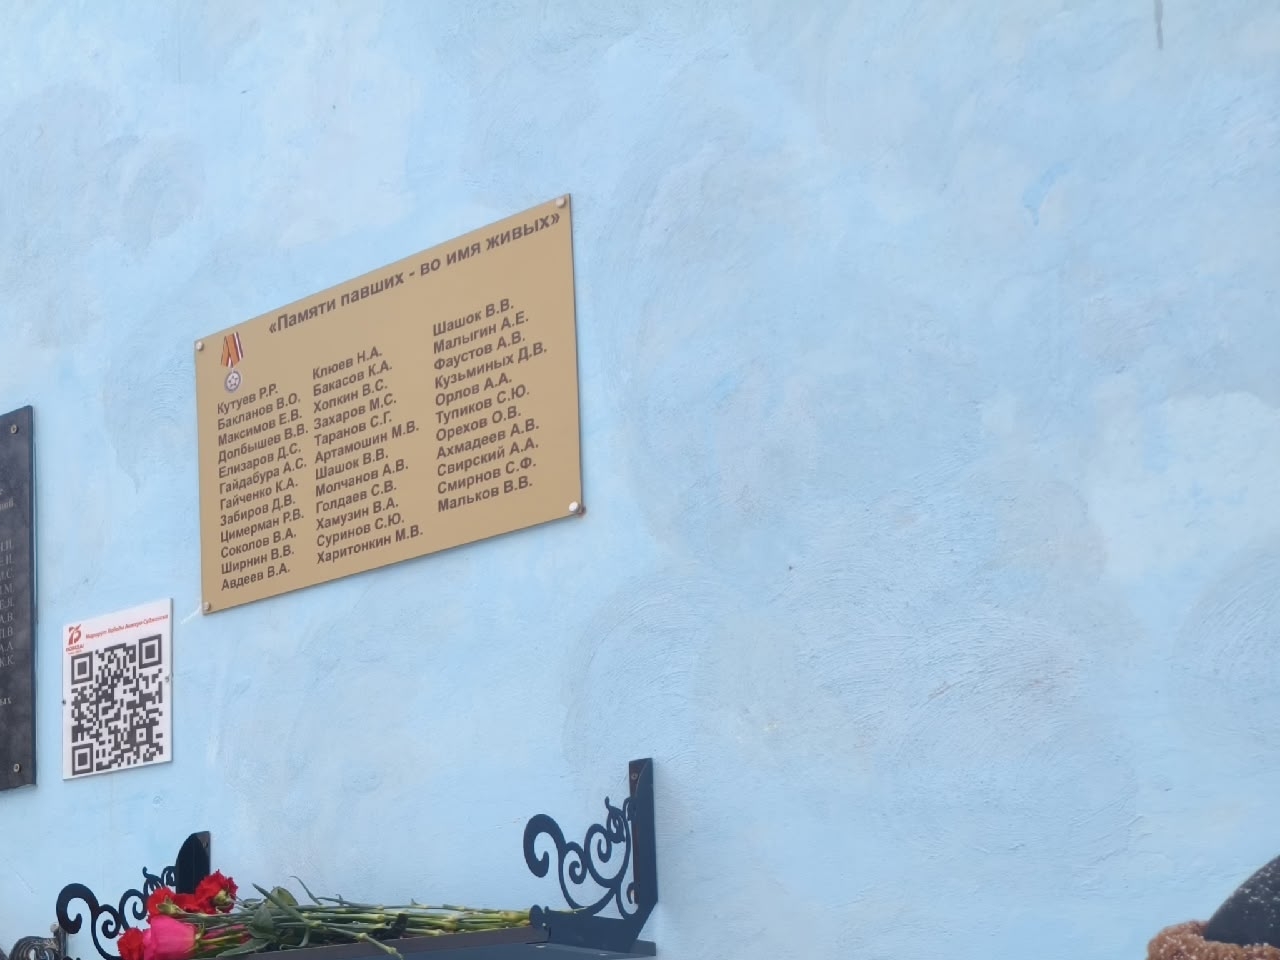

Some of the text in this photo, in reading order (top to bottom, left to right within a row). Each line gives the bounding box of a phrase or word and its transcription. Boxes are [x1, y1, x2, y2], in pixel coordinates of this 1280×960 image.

[269, 298, 336, 334] «Памяти
[341, 272, 404, 307] павших
[420, 258, 441, 277] во
[446, 242, 481, 266] имя
[486, 212, 561, 251] живых»
[433, 298, 514, 337] Шашок В.В.
[433, 310, 529, 354] Малыгин А.Е.
[312, 346, 383, 380] Клюев Н.А.
[434, 331, 525, 370] Фаустов А.В.
[435, 342, 547, 390] Кузьминых Д.В.
[313, 360, 392, 397] Бакасов К.А.
[313, 378, 388, 414] Хопкин В.С.
[435, 372, 512, 406] Орлов А.А.
[217, 383, 278, 415] Кутуев Р.Р.
[217, 392, 301, 431] Бакланов В.О.
[314, 393, 397, 430] Захаров М.С.
[435, 384, 530, 425] Тупиков С.Ю.
[218, 408, 302, 447] Максимов Е.В.
[313, 410, 392, 446] Таранов С.Г.
[314, 420, 419, 464] Артамошин М.В.
[436, 405, 521, 442] Орехов О.В.
[436, 418, 539, 460] Ахмадеев А.В.
[218, 423, 308, 465] Долбышев В.В.
[219, 442, 301, 479] Елизаров Д.С.
[437, 437, 539, 477] Свирский А.А.
[219, 457, 307, 495] Гайдабура А.С.
[315, 448, 388, 481] Шашок В.В.
[315, 458, 408, 497] Молчанов А.В.
[437, 457, 536, 494] Смирнов С.Ф.
[220, 477, 298, 511] Гайченко К.А.
[220, 494, 296, 527] Забиров Д.В.
[316, 479, 397, 514] Голдаев С.В.
[438, 475, 533, 513] Мальков В.В.
[220, 508, 304, 543] Цимерман Р.В.
[316, 497, 399, 531] Хамузин В.А.
[316, 512, 404, 548] Суринов С.Ю.
[220, 527, 296, 559] Соколов В.А.
[221, 544, 294, 575] Ширнин В.В.
[317, 524, 423, 564] Харитонкин М.В.
[221, 562, 290, 591] Авдеев В.А.
